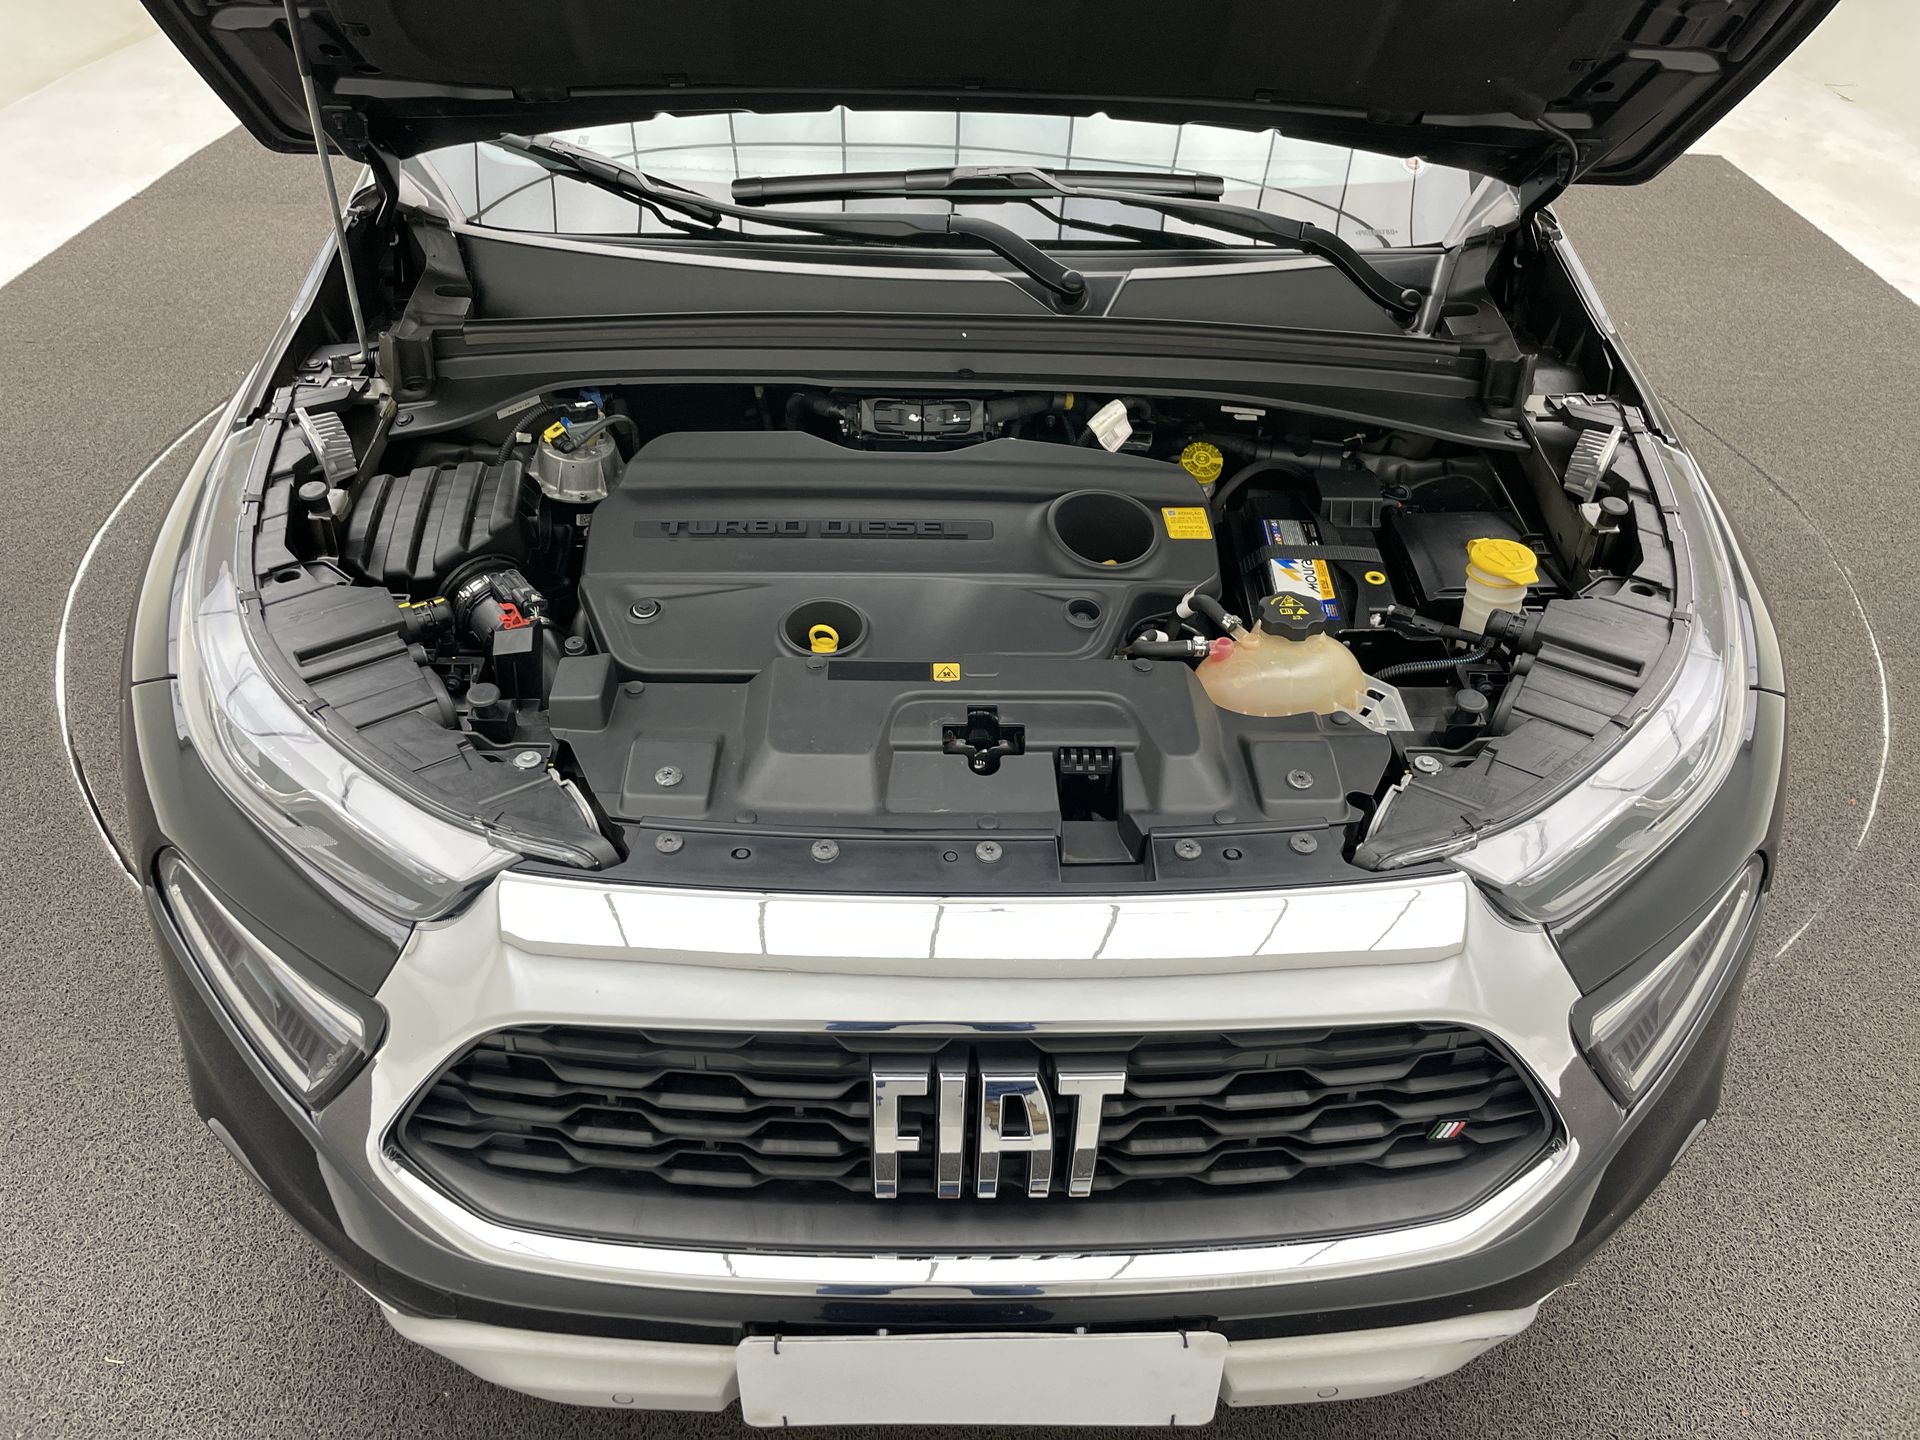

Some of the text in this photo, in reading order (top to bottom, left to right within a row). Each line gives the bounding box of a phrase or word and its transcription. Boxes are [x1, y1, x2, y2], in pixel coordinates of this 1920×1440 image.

[660, 519, 969, 538] TURBO DIESEL
[872, 1072, 1126, 1199] FIAT
